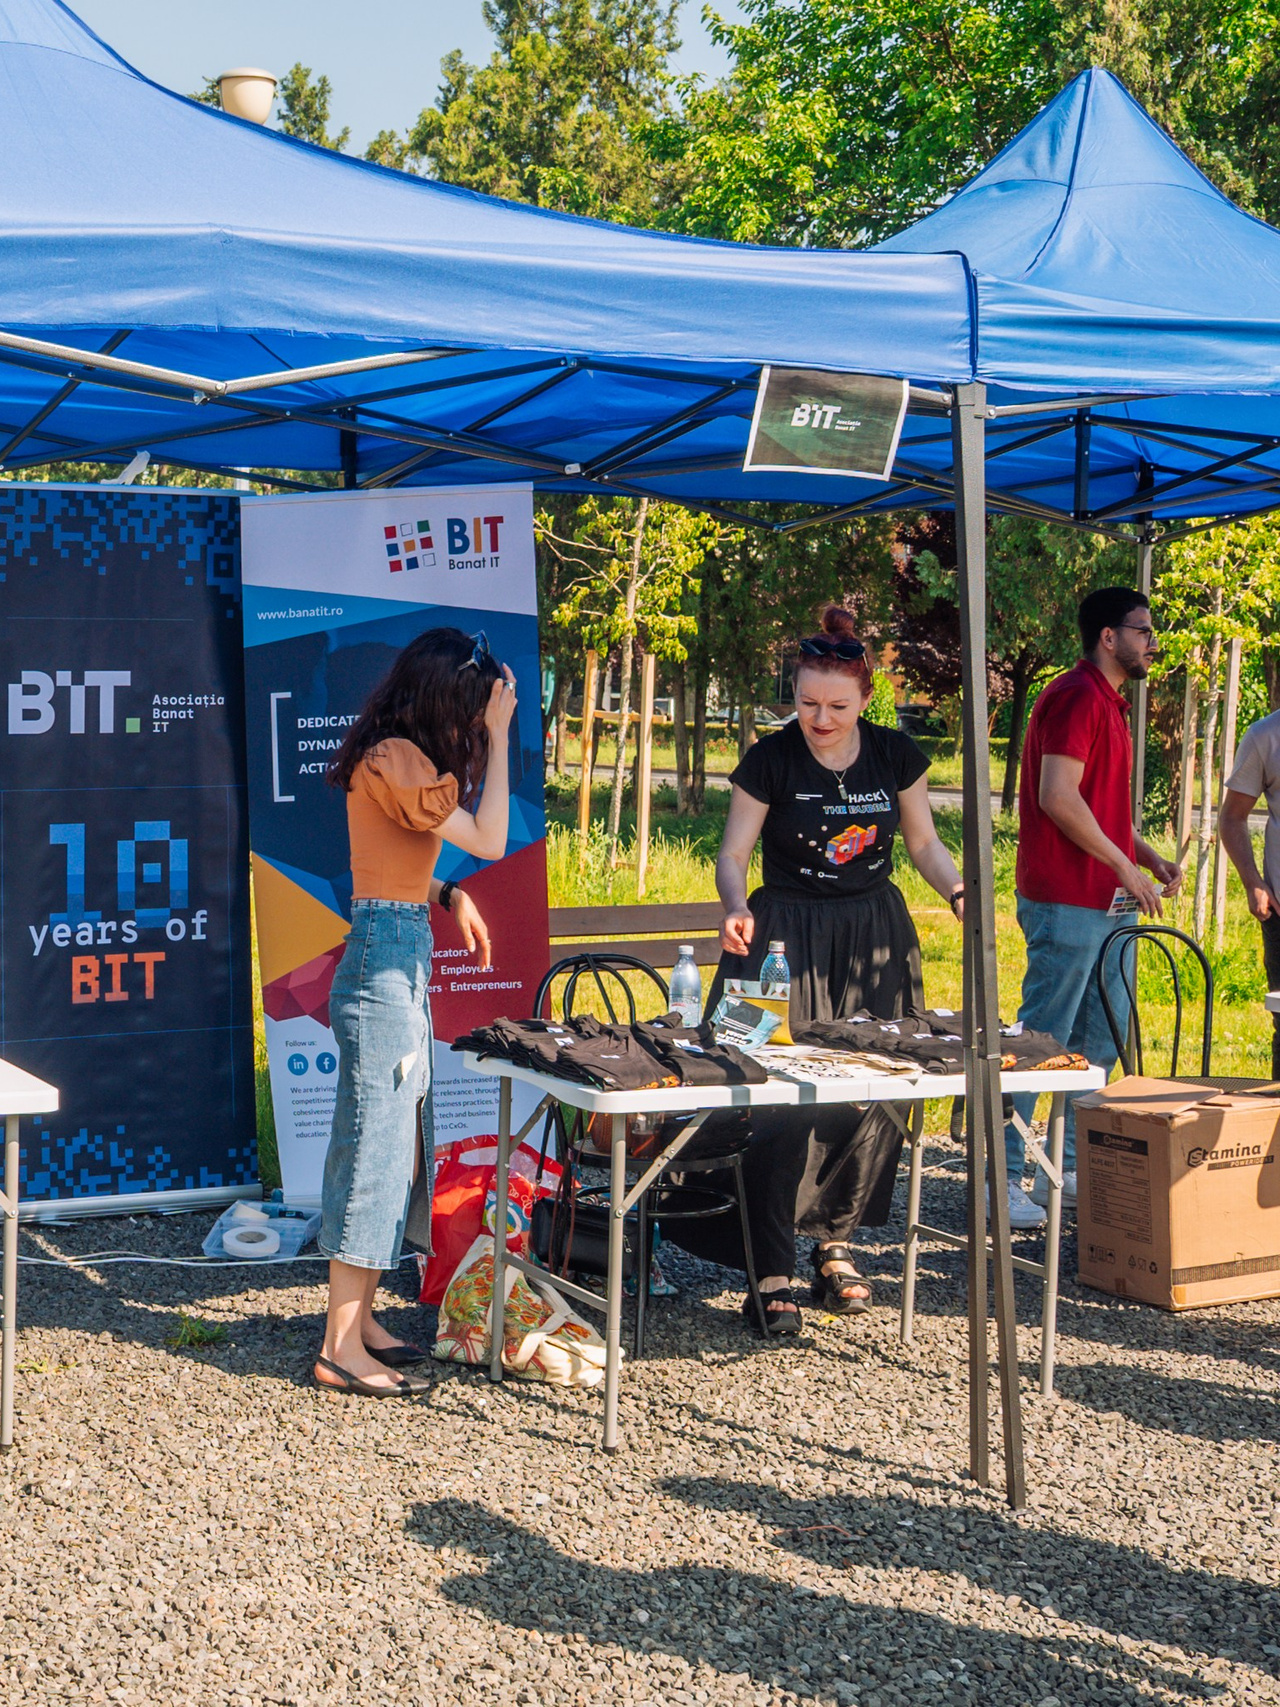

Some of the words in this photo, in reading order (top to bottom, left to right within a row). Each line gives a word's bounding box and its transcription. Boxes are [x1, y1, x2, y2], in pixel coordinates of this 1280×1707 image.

[790, 403, 842, 430] BIT
[446, 515, 504, 555] BIT
[448, 556, 487, 570] Banat
[489, 556, 500, 568] IT
[256, 606, 344, 621] www.banatit.ro
[152, 694, 225, 708] Asociația
[152, 708, 194, 719] Banat
[152, 721, 170, 733] IT
[848, 790, 882, 803] HACK
[49, 820, 189, 933] 10
[28, 919, 139, 957] years
[165, 909, 208, 942] of
[71, 951, 166, 1005] BIT
[450, 980, 523, 992] Entrepreneurs
[285, 1040, 307, 1048] Follow
[433, 1077, 460, 1086] towards
[461, 1076, 493, 1084] increased
[440, 1089, 475, 1097] relevance,
[433, 1100, 461, 1108] business
[462, 1098, 494, 1107] practices,
[439, 1111, 454, 1119] tech
[467, 1109, 496, 1118] business
[294, 1120, 312, 1128] value
[448, 1121, 469, 1130] CxOs.
